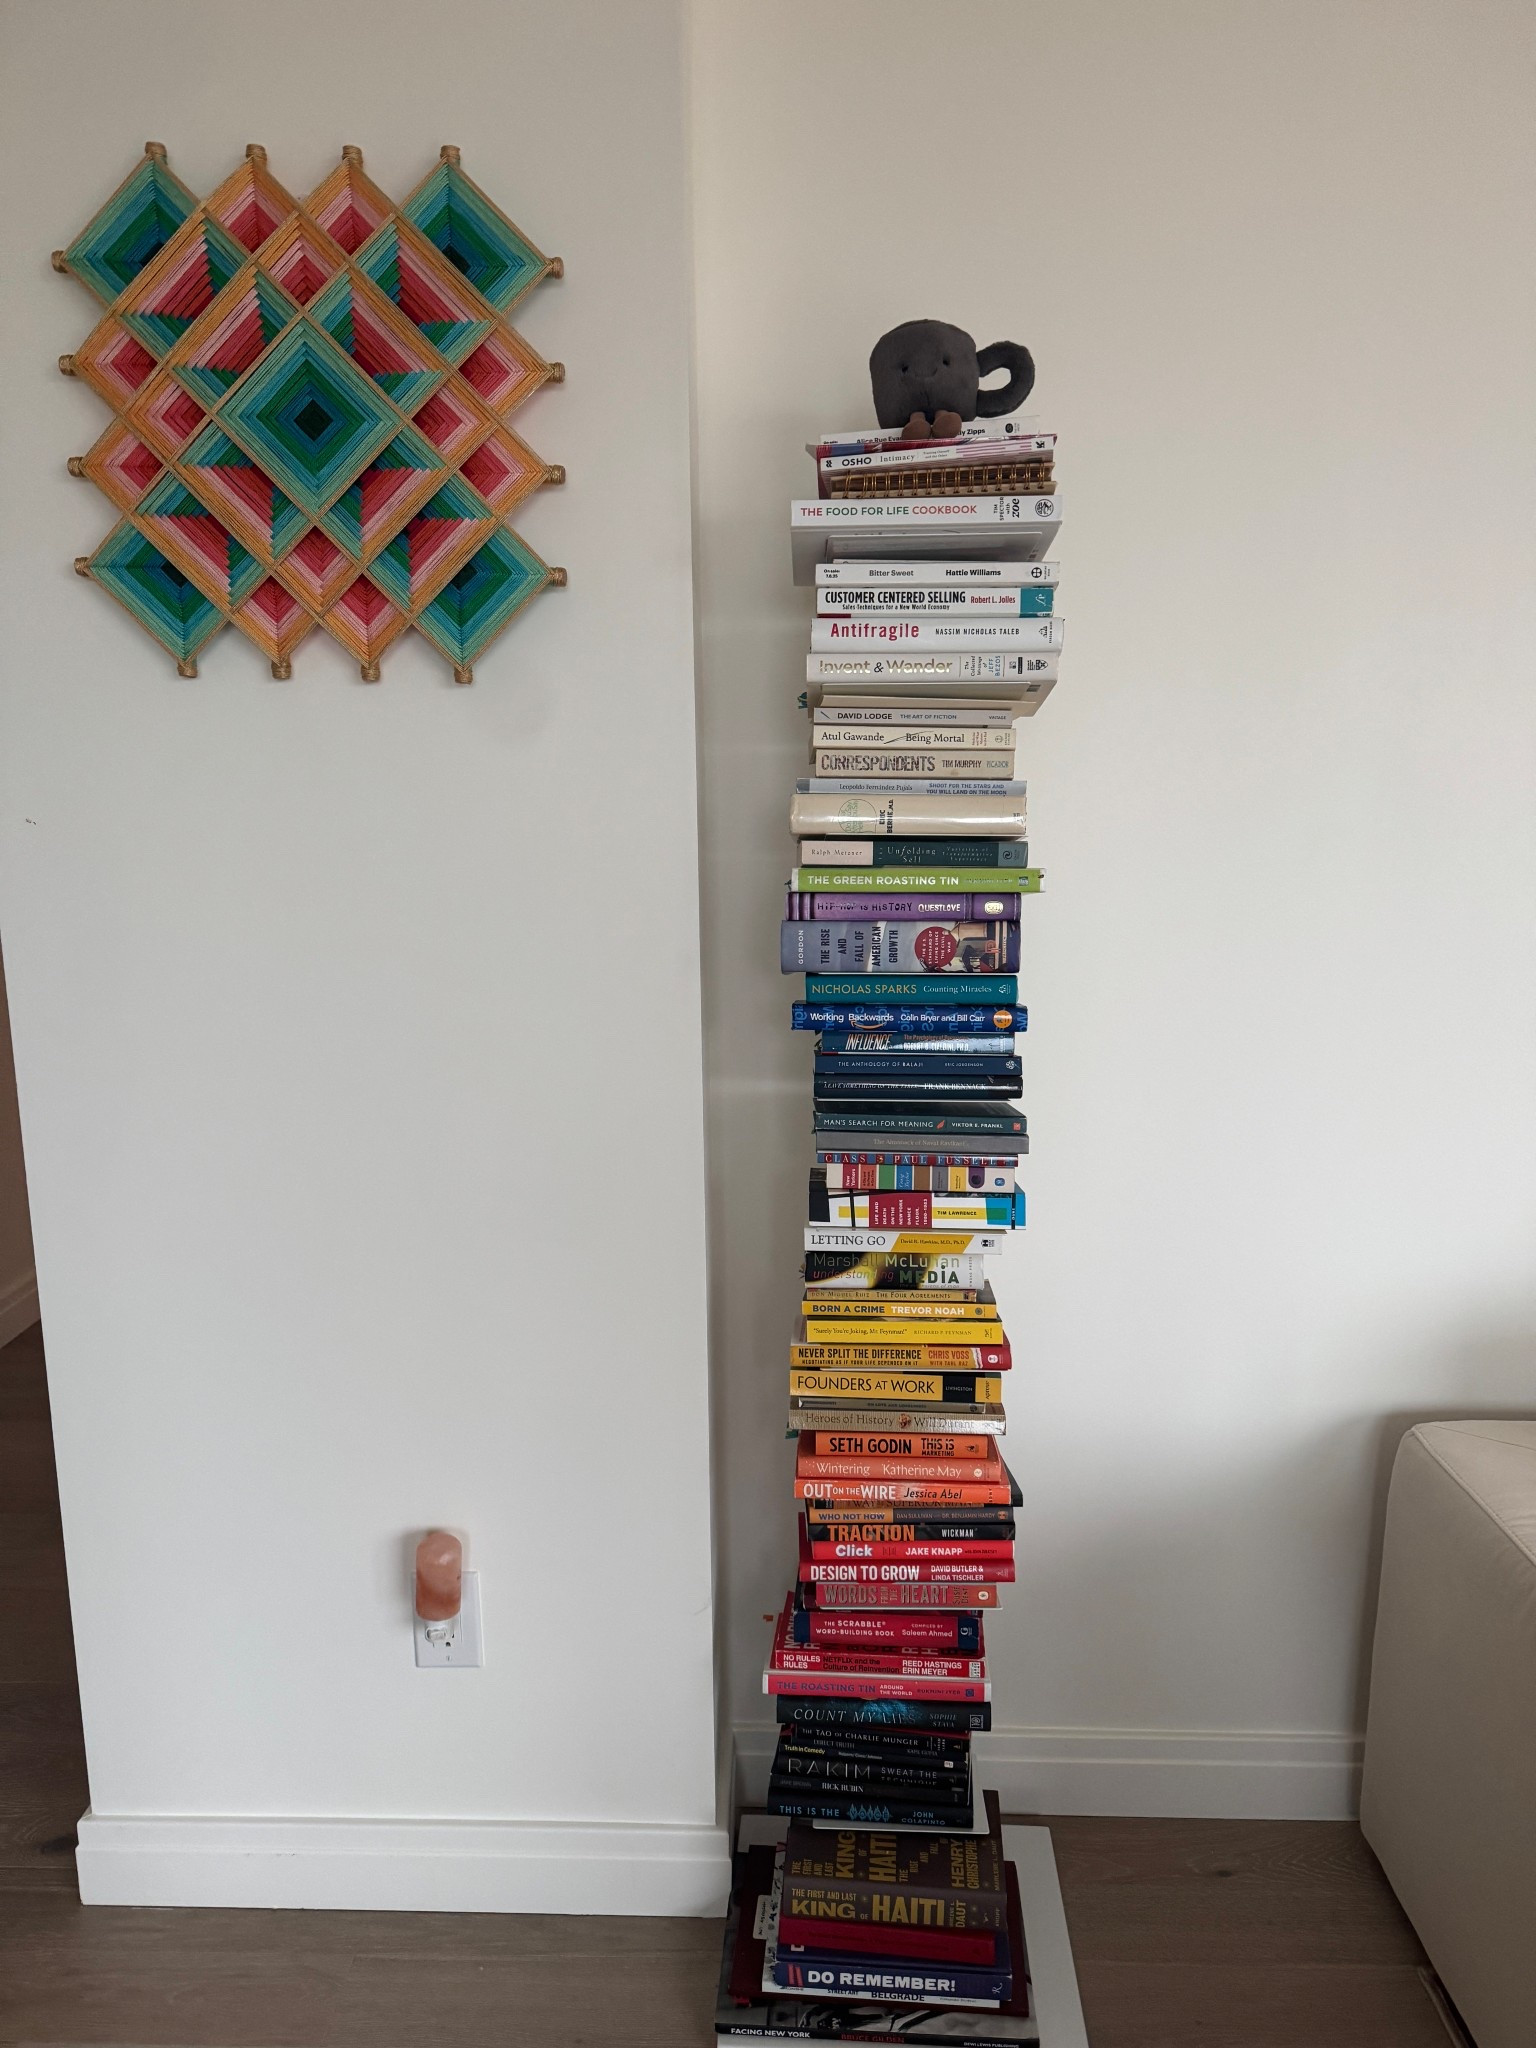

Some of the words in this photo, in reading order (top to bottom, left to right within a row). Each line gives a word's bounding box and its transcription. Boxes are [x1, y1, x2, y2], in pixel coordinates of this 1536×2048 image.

[842, 457, 872, 466] OSHO
[880, 453, 915, 463] Intimacy
[801, 508, 822, 516] THE
[826, 507, 857, 515] FOOD
[862, 507, 883, 515] FOR
[887, 506, 909, 515] LIFE
[912, 505, 976, 514] COOKBOOK
[825, 592, 874, 603] CUSTOMER
[877, 592, 925, 603] CENTERED
[928, 592, 965, 603] SELLING
[831, 623, 919, 641] Antifragile
[819, 660, 870, 673] Invent
[874, 663, 884, 672] &
[887, 660, 952, 673] Wander
[821, 732, 841, 740] Atul
[844, 732, 884, 742] Gawande
[906, 733, 931, 744] Being
[934, 734, 964, 743] Mortal
[821, 755, 935, 771] CORRESPONDENTS
[808, 876, 830, 885] THE
[834, 876, 872, 885] GREEN
[877, 876, 935, 885] ROASTING
[940, 877, 958, 885] TIN
[821, 929, 830, 947] RISE
[856, 931, 864, 941] OF
[838, 938, 847, 954] AND
[872, 927, 880, 966] AMERICAN
[889, 930, 898, 963] GROWTH
[821, 950, 830, 964] THE
[855, 944, 864, 962] FALL
[812, 985, 871, 994] NICHOLAS
[875, 985, 916, 994] SPARKS
[923, 985, 958, 993] Counting
[810, 1013, 844, 1022] Working
[921, 1014, 939, 1022] Bryar
[957, 1014, 967, 1022] Bill
[846, 1034, 891, 1049] INFLUENCE
[825, 1154, 866, 1163] CLASS
[894, 1154, 927, 1164] PAUL
[811, 1235, 863, 1245] LETTING
[867, 1236, 885, 1245] GO
[814, 1254, 878, 1266] Marshall
[854, 1306, 885, 1314] CRIME
[935, 1307, 964, 1315] NOAH
[799, 1348, 824, 1358] NEVER
[828, 1349, 850, 1358] SPLIT
[854, 1349, 869, 1359] THE
[872, 1349, 921, 1359] DIFFERENCE
[928, 1350, 949, 1359] CHRIS
[951, 1351, 969, 1359] VOSS
[798, 1376, 871, 1391] FOUNDERS
[875, 1380, 888, 1390] AT
[891, 1380, 934, 1393] WORK
[806, 1414, 841, 1424] Heroes
[844, 1414, 853, 1424] of
[856, 1415, 893, 1426] History
[830, 1438, 863, 1452] SETH
[868, 1439, 912, 1454] GODIN
[817, 1463, 870, 1476] Wintering
[883, 1465, 934, 1476] Katherine
[937, 1466, 961, 1478] May
[804, 1484, 832, 1498] OUT
[833, 1487, 844, 1495] ON
[861, 1485, 896, 1499] WIRE
[904, 1487, 937, 1499] Jessica
[828, 1525, 915, 1541] TRACTION
[836, 1545, 872, 1557] Click
[906, 1547, 929, 1555] JAKE
[932, 1547, 962, 1556] KNAPP
[811, 1566, 857, 1580] DESIGN
[861, 1566, 877, 1580] TO
[881, 1566, 919, 1580] GROW
[824, 1585, 877, 1604] WORDS
[901, 1586, 949, 1604] HEART
[798, 1655, 820, 1663] RULES
[823, 1656, 852, 1665] NETFLIX
[902, 1660, 922, 1668] REED
[924, 1661, 962, 1670] HASTINGS
[794, 1708, 846, 1720] COUNT
[853, 1711, 873, 1723] MY
[882, 1712, 915, 1724] LIES
[845, 1733, 879, 1742] CHARLIE
[883, 1736, 918, 1745] MUNGER
[788, 1758, 870, 1779] RAKIM
[780, 1806, 804, 1814] THIS
[807, 1807, 817, 1815] IS
[821, 1808, 839, 1816] THE
[951, 1839, 964, 1887] HENRY
[807, 1890, 825, 1898] FIRST
[827, 1892, 839, 1900] AND
[842, 1893, 856, 1901] LAST
[792, 1900, 856, 1918] KING
[872, 1895, 944, 1926] HAITI
[808, 1971, 834, 1983] DO
[840, 1973, 955, 1991] REMEMBER!
[731, 2028, 762, 2036] FACING
[765, 2029, 785, 2037] NEW
[788, 2030, 810, 2038] YORK
